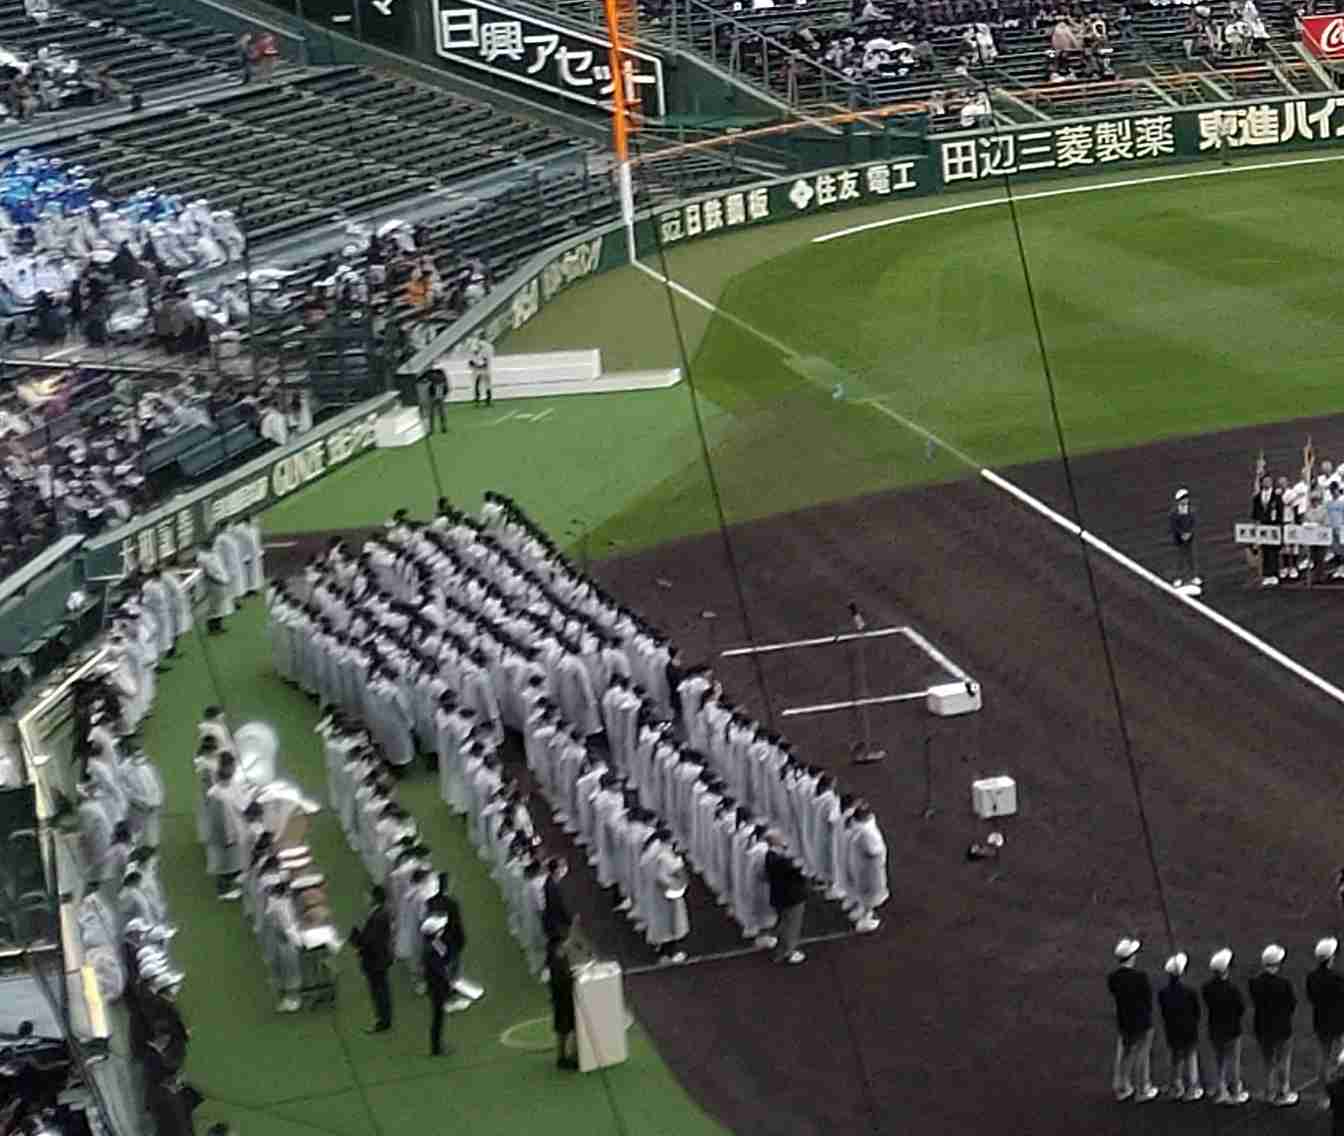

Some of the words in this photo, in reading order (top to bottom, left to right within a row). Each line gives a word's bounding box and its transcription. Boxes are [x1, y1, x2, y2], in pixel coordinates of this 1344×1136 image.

[441, 8, 656, 103] 日興アセット
[941, 114, 1176, 184] 田辺三菱製薬
